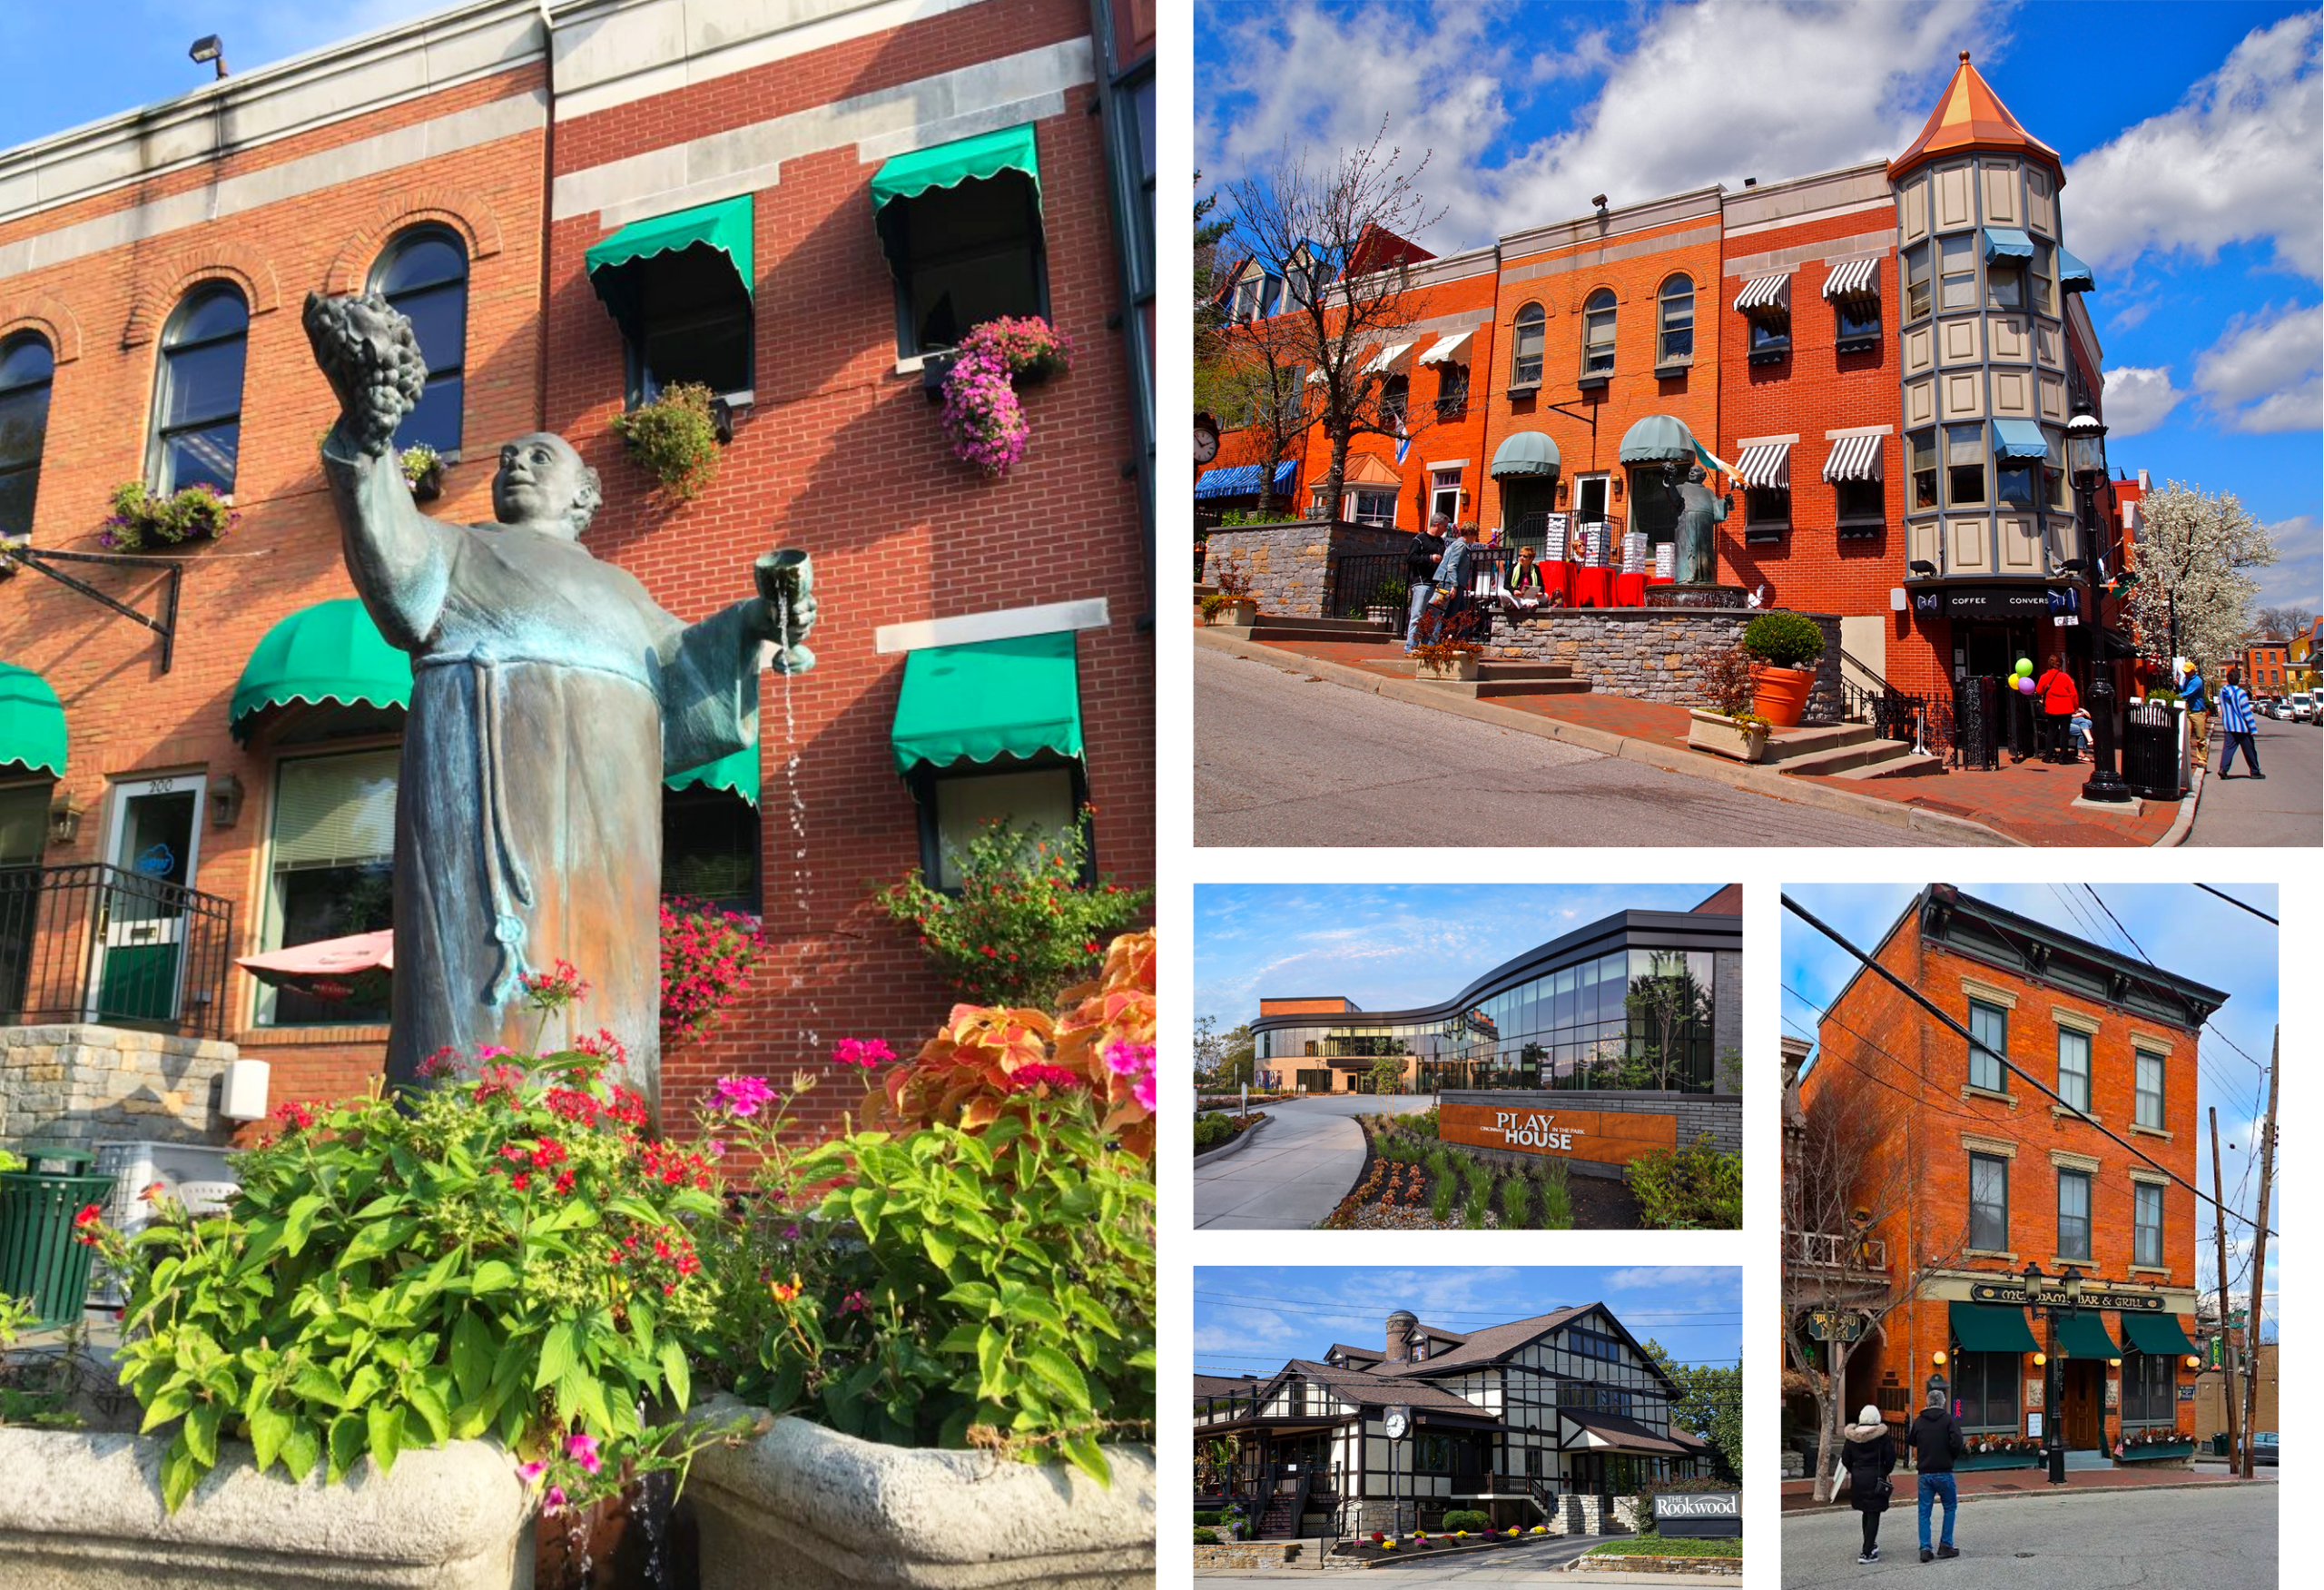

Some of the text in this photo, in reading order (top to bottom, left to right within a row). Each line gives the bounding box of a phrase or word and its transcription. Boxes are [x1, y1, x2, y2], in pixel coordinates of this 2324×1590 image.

[149, 779, 173, 794] 200
[1495, 1112, 1556, 1132] PLAY
[1505, 1129, 1573, 1151] HOUSE
[2078, 1295, 2100, 1306] BAR
[2102, 1297, 2112, 1306] &
[2114, 1298, 2143, 1308] GRILL
[1657, 1495, 1738, 1517] Rookwood
